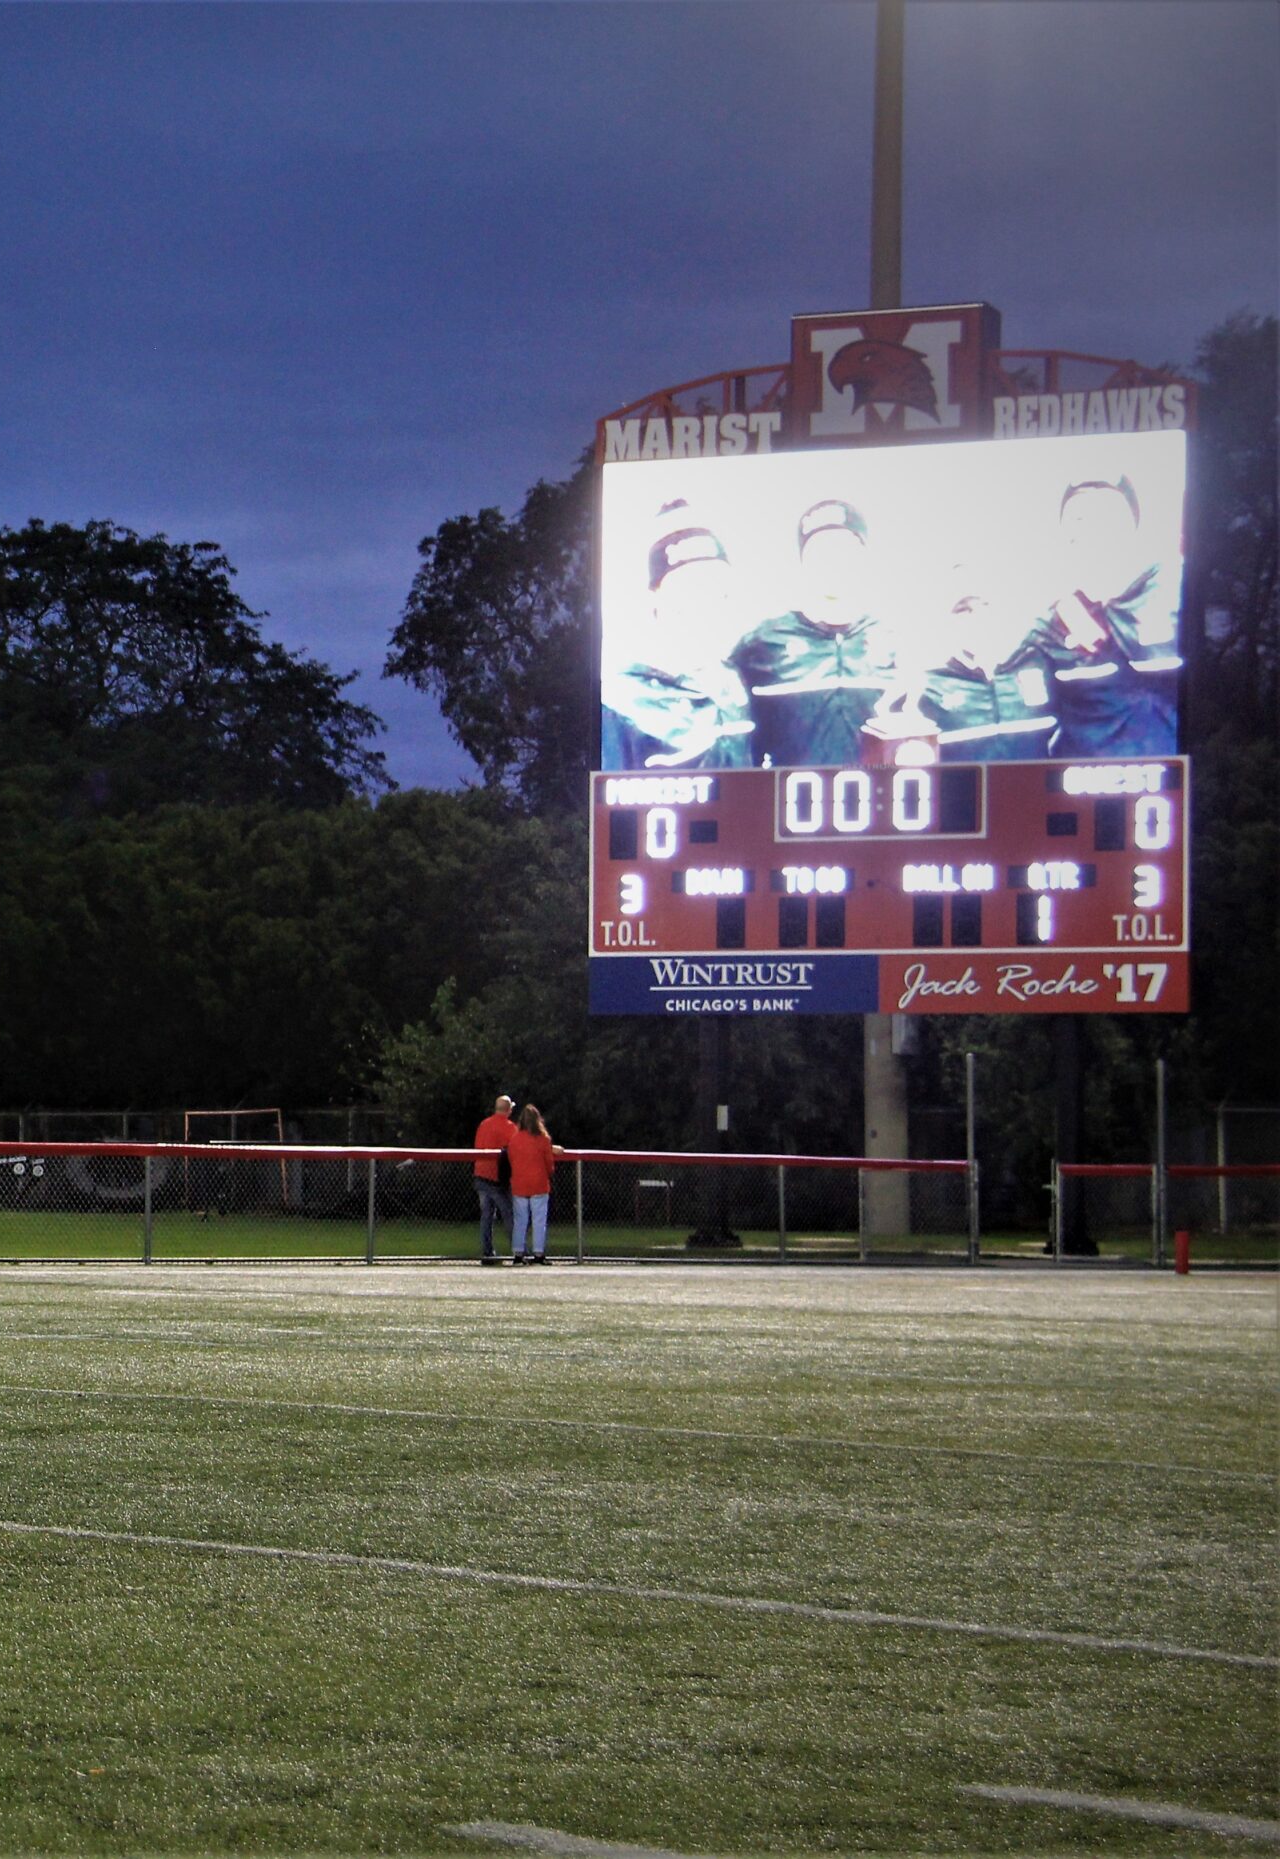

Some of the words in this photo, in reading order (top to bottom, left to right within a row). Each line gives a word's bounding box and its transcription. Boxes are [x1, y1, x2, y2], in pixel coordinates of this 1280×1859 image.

[993, 384, 1186, 440] REDHAWKS
[605, 411, 781, 461] MARIST
[646, 808, 677, 859] 0
[1134, 795, 1171, 850] 0
[620, 874, 644, 915] 3
[1133, 864, 1161, 908] 3
[601, 920, 656, 946] T.O.L.
[1037, 894, 1053, 942] 1
[1112, 914, 1175, 941] T.O.L.
[649, 958, 814, 986] WINTRUST
[898, 963, 981, 1009] Jack
[996, 963, 1099, 1001] Roche
[1102, 963, 1168, 1002] '17
[665, 998, 747, 1012] CHICAGO'S
[752, 998, 795, 1012] BANK
